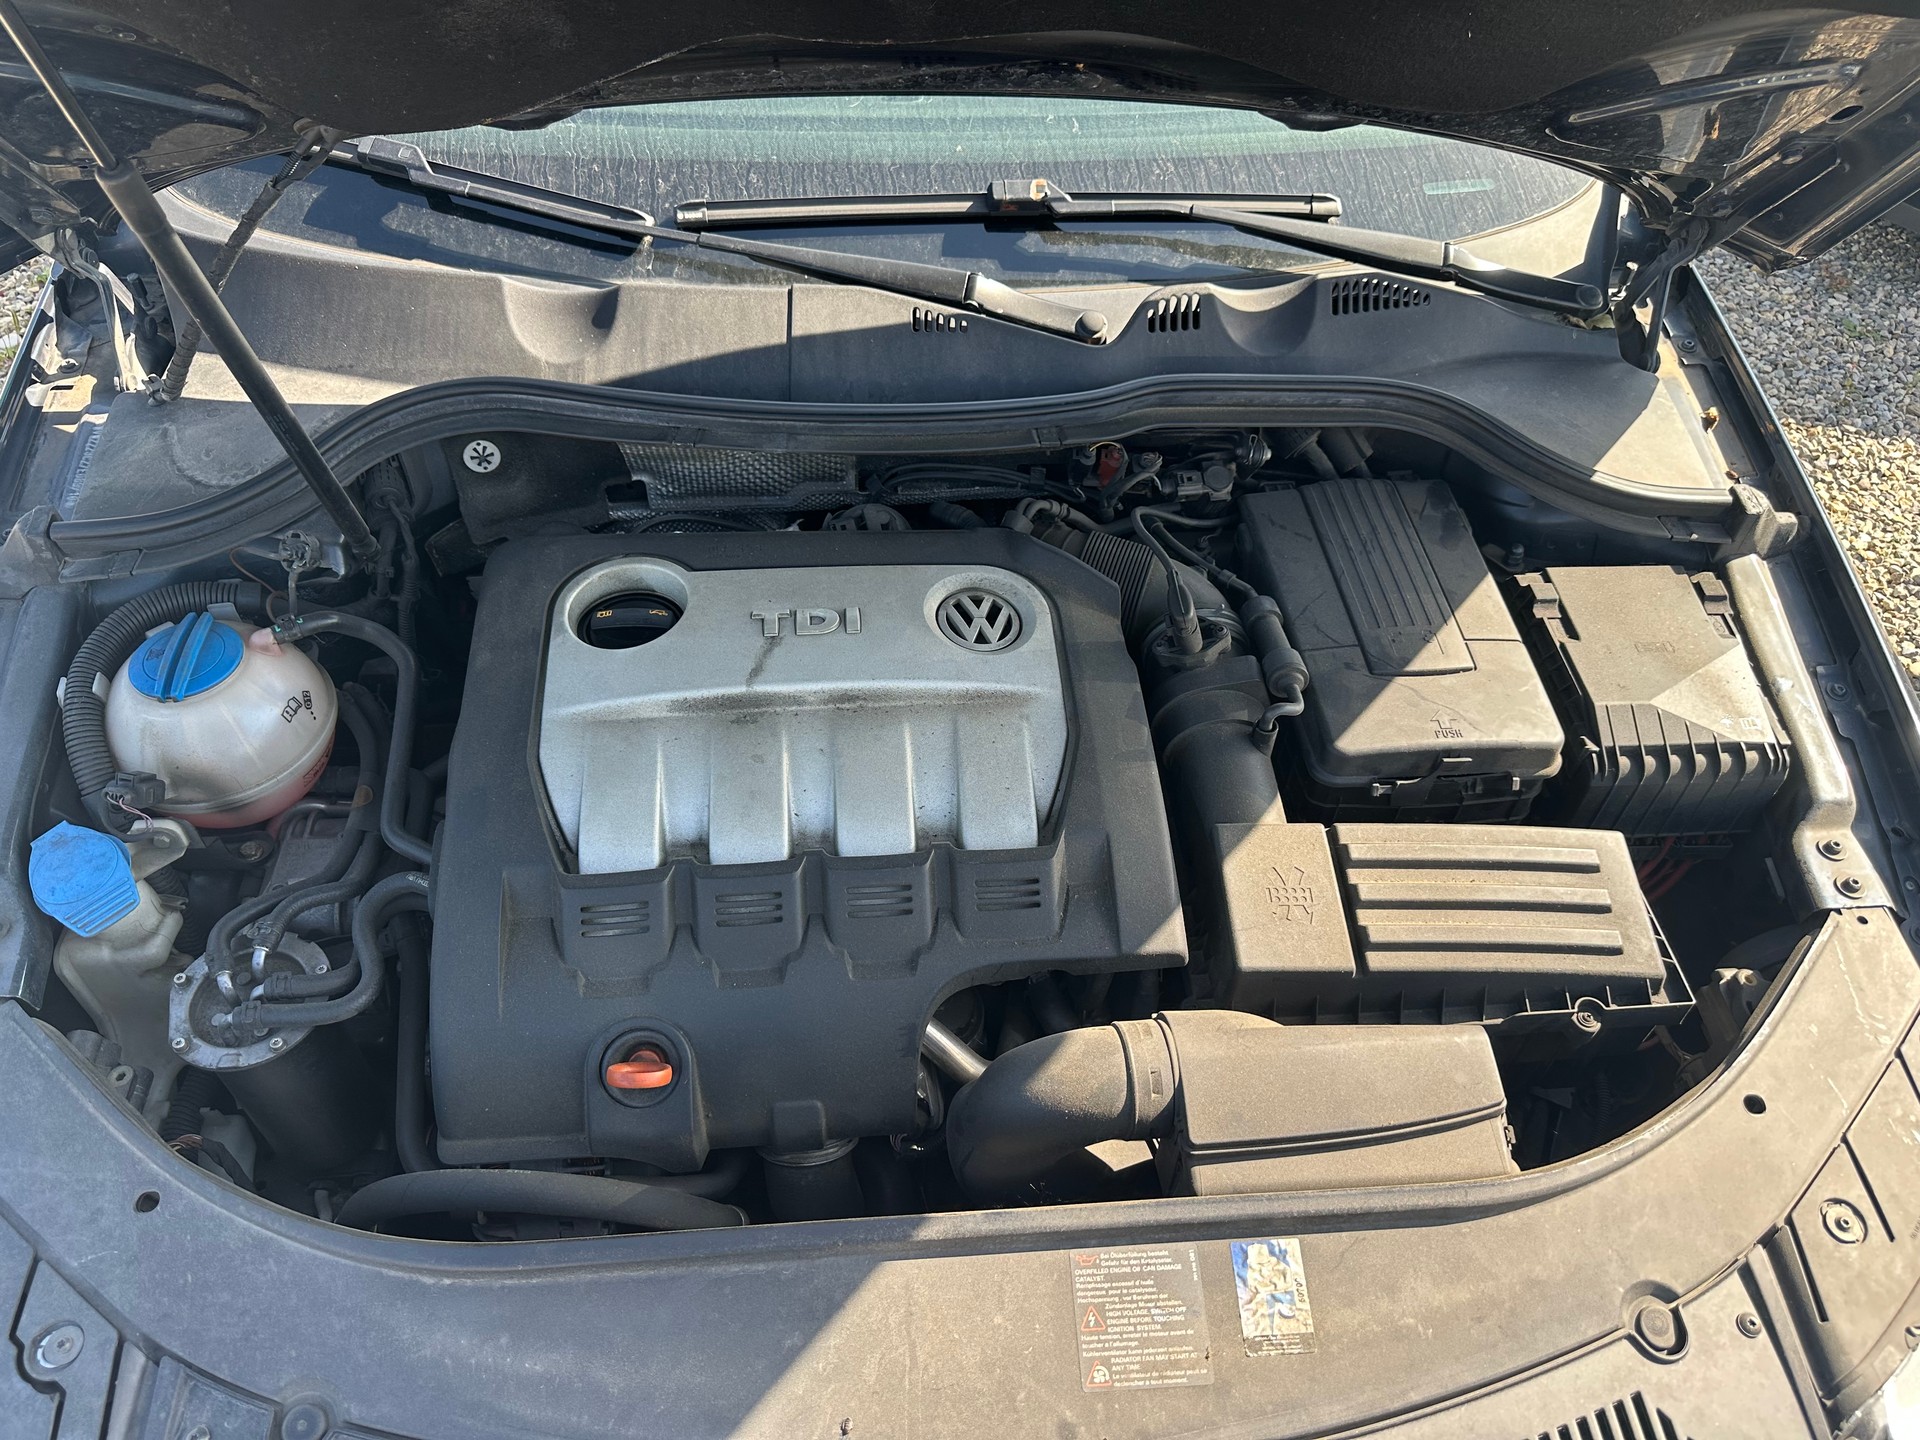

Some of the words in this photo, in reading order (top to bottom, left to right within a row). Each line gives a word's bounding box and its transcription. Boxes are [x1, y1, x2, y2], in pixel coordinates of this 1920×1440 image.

[751, 607, 862, 637] TDI
[937, 589, 1022, 652] VW
[303, 691, 312, 709] G12
[1434, 729, 1463, 739] PUSH
[1075, 1267, 1110, 1275] OVERFILLED
[1143, 1264, 1156, 1272] CAN
[1156, 1263, 1182, 1271] DAMAGE
[1130, 1316, 1153, 1324] BEFORE
[1153, 1314, 1185, 1322] TOUCHING
[1111, 1355, 1142, 1363] RADIATOR
[1142, 1354, 1155, 1362] FAN
[1155, 1353, 1169, 1361] MAY
[1169, 1352, 1190, 1360] START
[1190, 1351, 1198, 1359] AT
